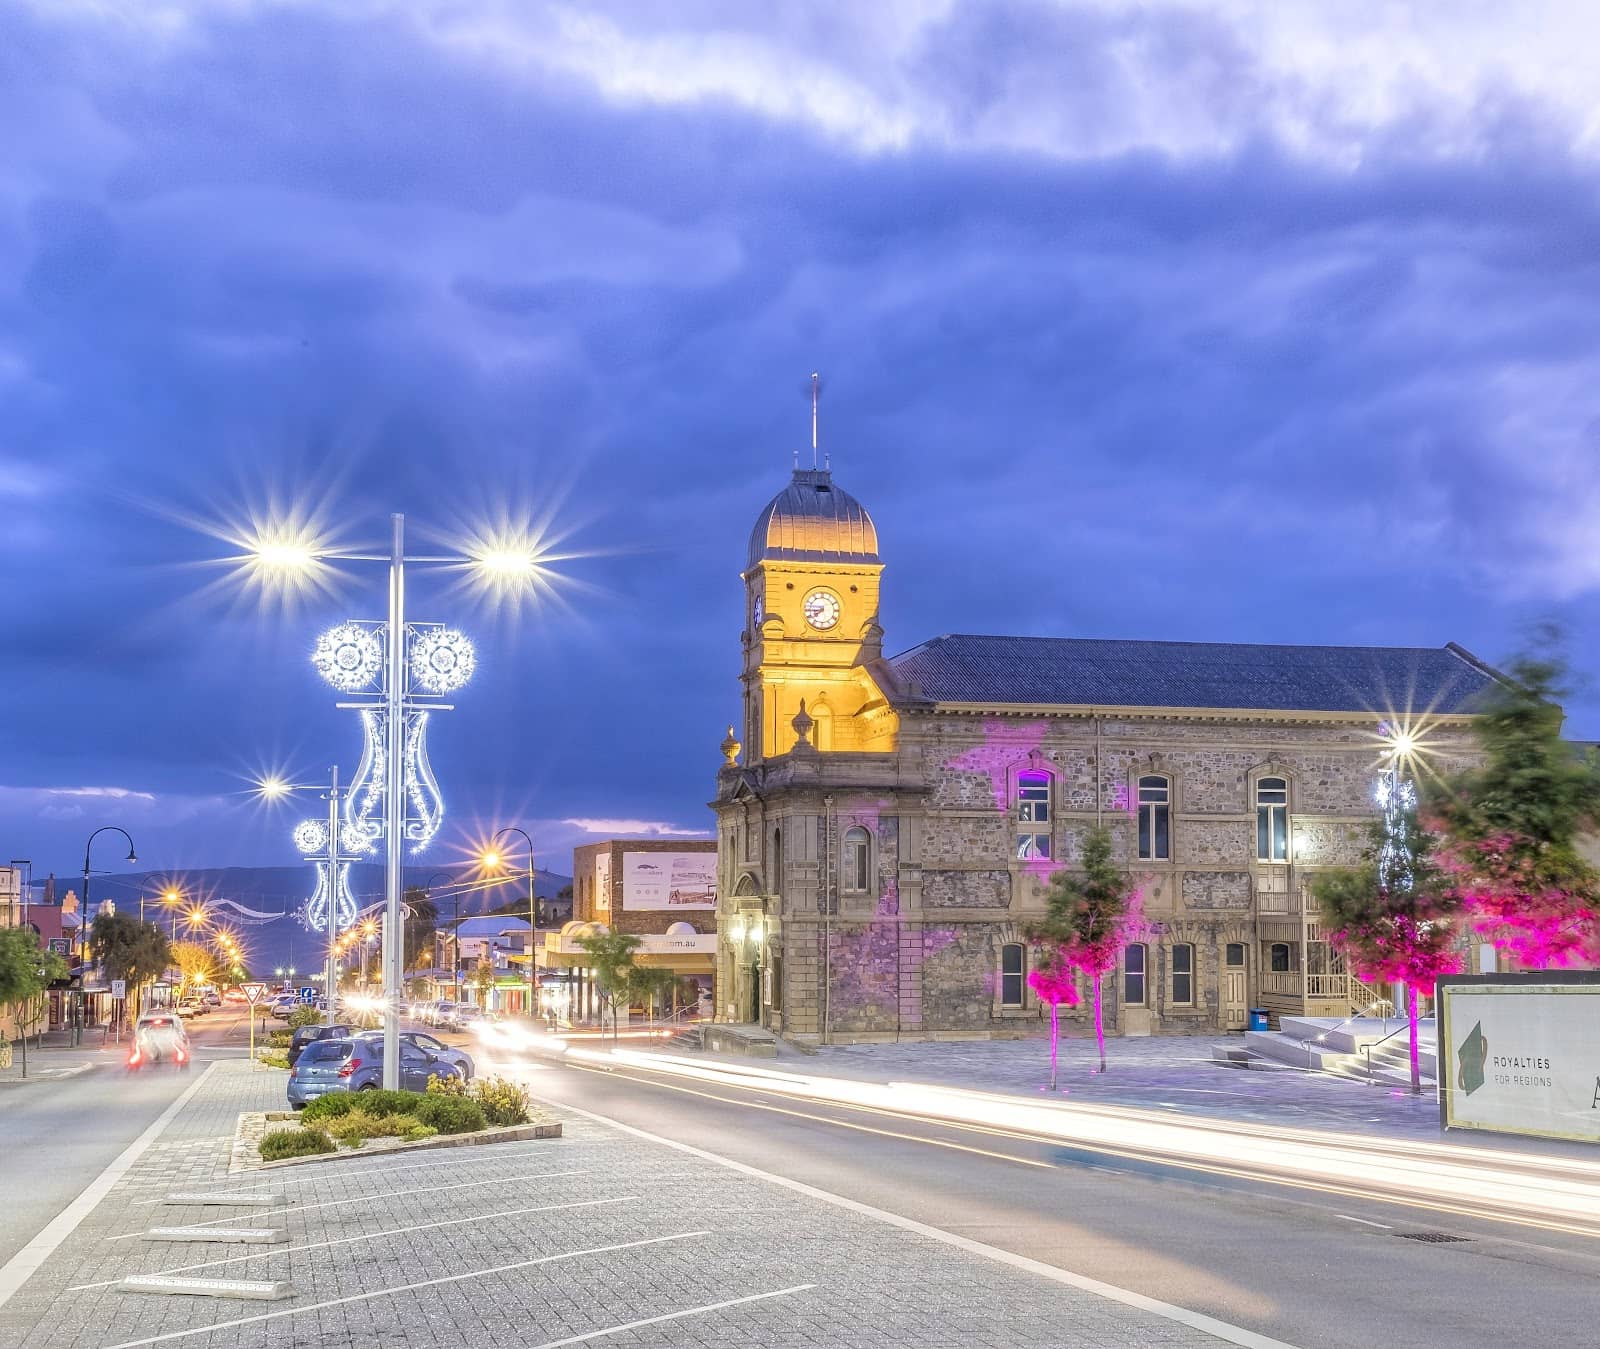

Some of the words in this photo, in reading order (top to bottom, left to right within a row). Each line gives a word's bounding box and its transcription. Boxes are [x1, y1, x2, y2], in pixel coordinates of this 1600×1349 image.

[1493, 1056, 1550, 1069] ROYALTIES
[1494, 1075, 1510, 1085] FOR
[1513, 1075, 1552, 1087] REGIONS
